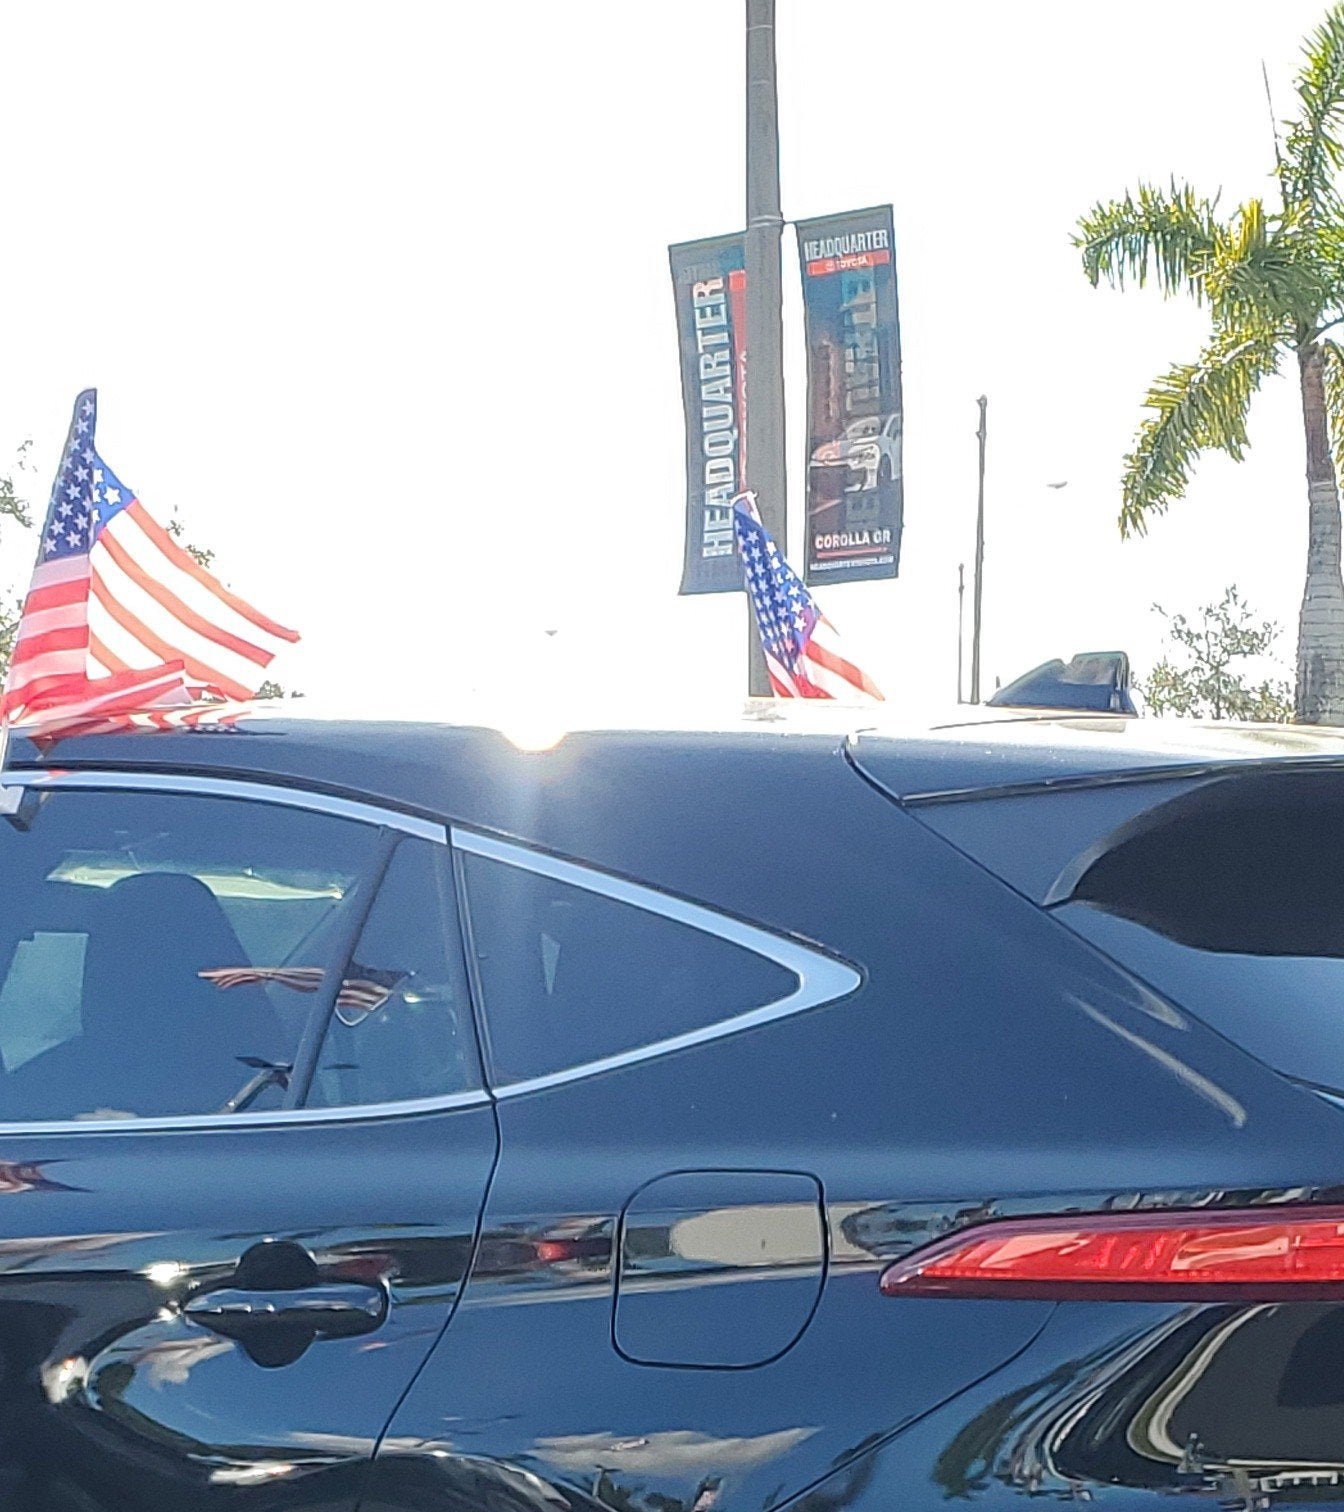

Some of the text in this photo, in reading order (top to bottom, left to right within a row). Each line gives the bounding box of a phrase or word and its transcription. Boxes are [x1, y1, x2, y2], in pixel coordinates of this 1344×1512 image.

[804, 229, 889, 261] HEADQUARTER
[692, 275, 738, 559] HEADQUARTER
[815, 530, 870, 549] COROLLA
